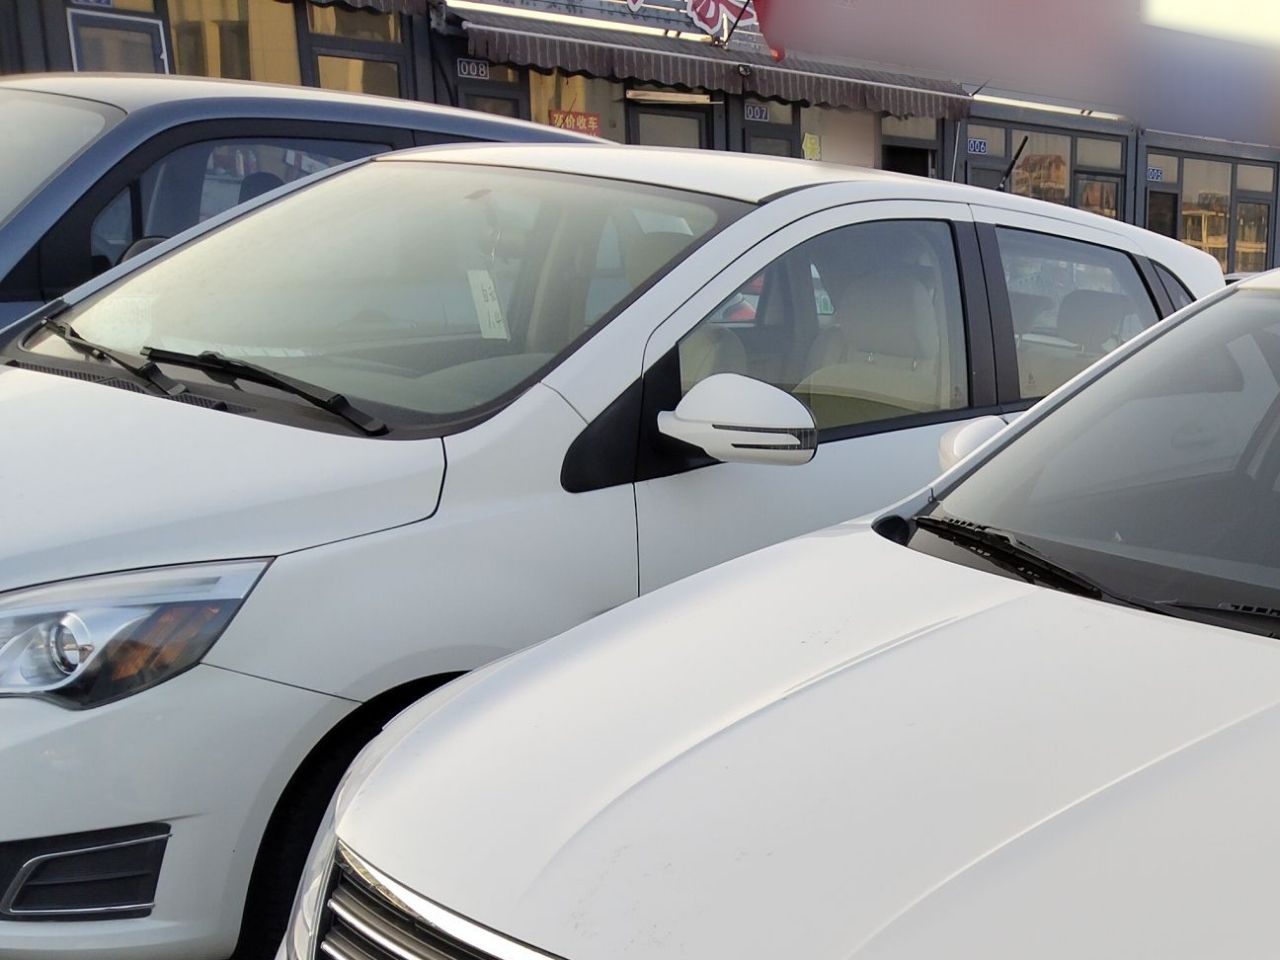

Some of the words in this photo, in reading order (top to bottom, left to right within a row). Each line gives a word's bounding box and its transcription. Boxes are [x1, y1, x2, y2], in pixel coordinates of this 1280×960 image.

[460, 61, 487, 77] 008
[746, 106, 767, 119] 007
[969, 140, 986, 152] 006
